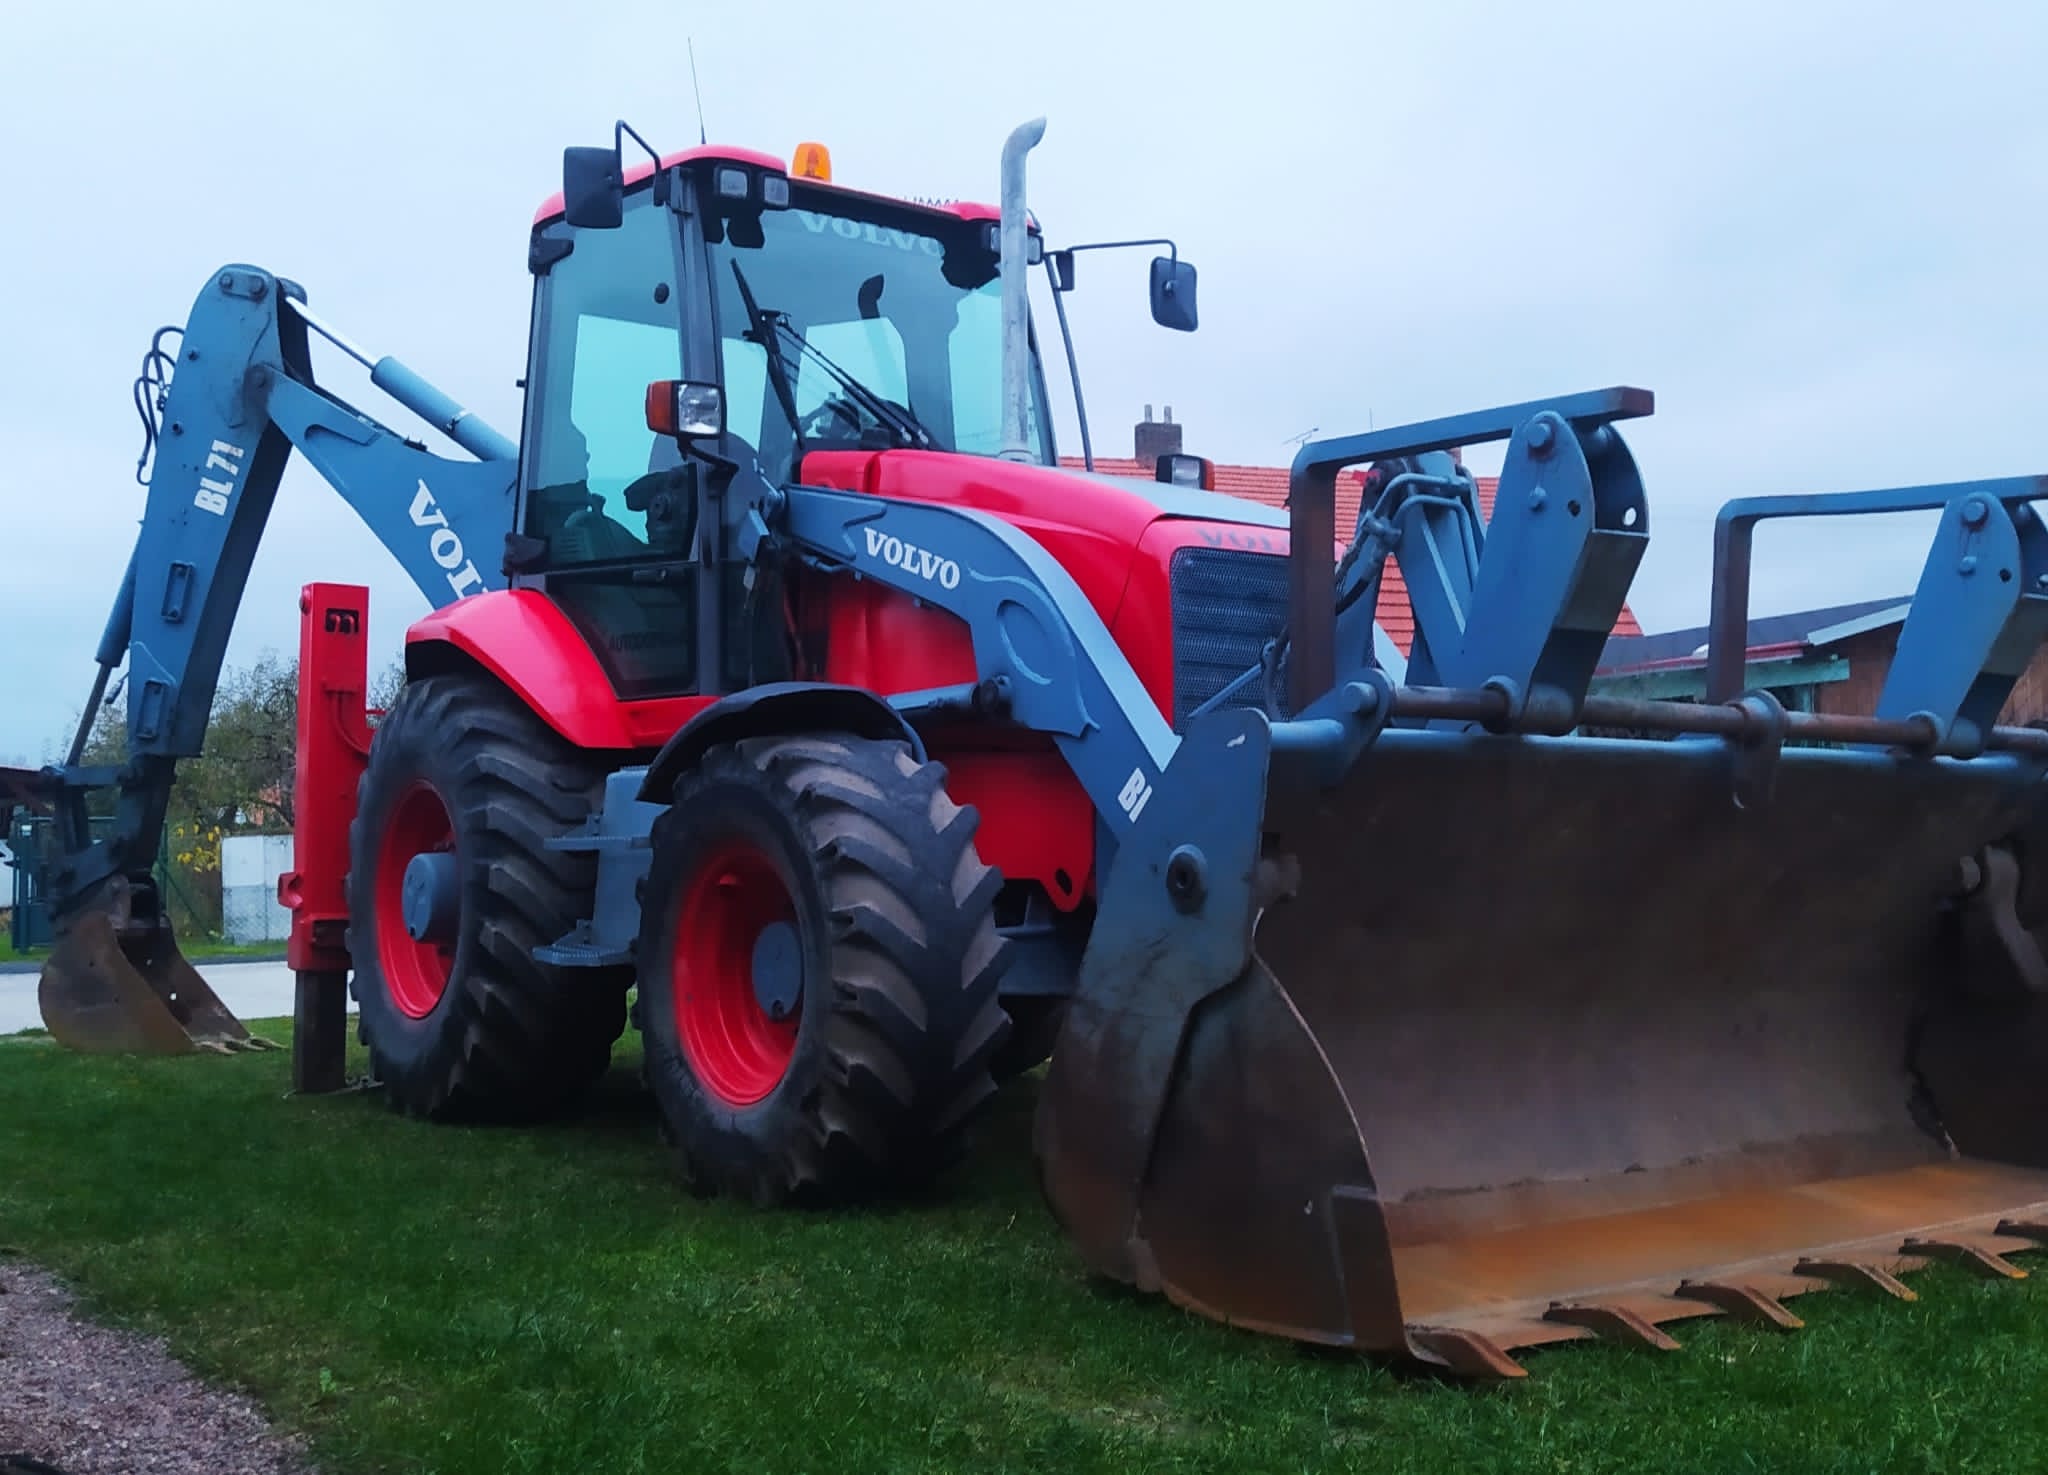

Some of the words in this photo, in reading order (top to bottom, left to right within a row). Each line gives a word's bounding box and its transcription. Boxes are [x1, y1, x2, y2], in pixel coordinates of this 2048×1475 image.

[799, 211, 946, 257] VOLVO
[194, 439, 245, 516] BL71
[408, 478, 488, 600] VOL
[863, 527, 961, 590] VOLVO
